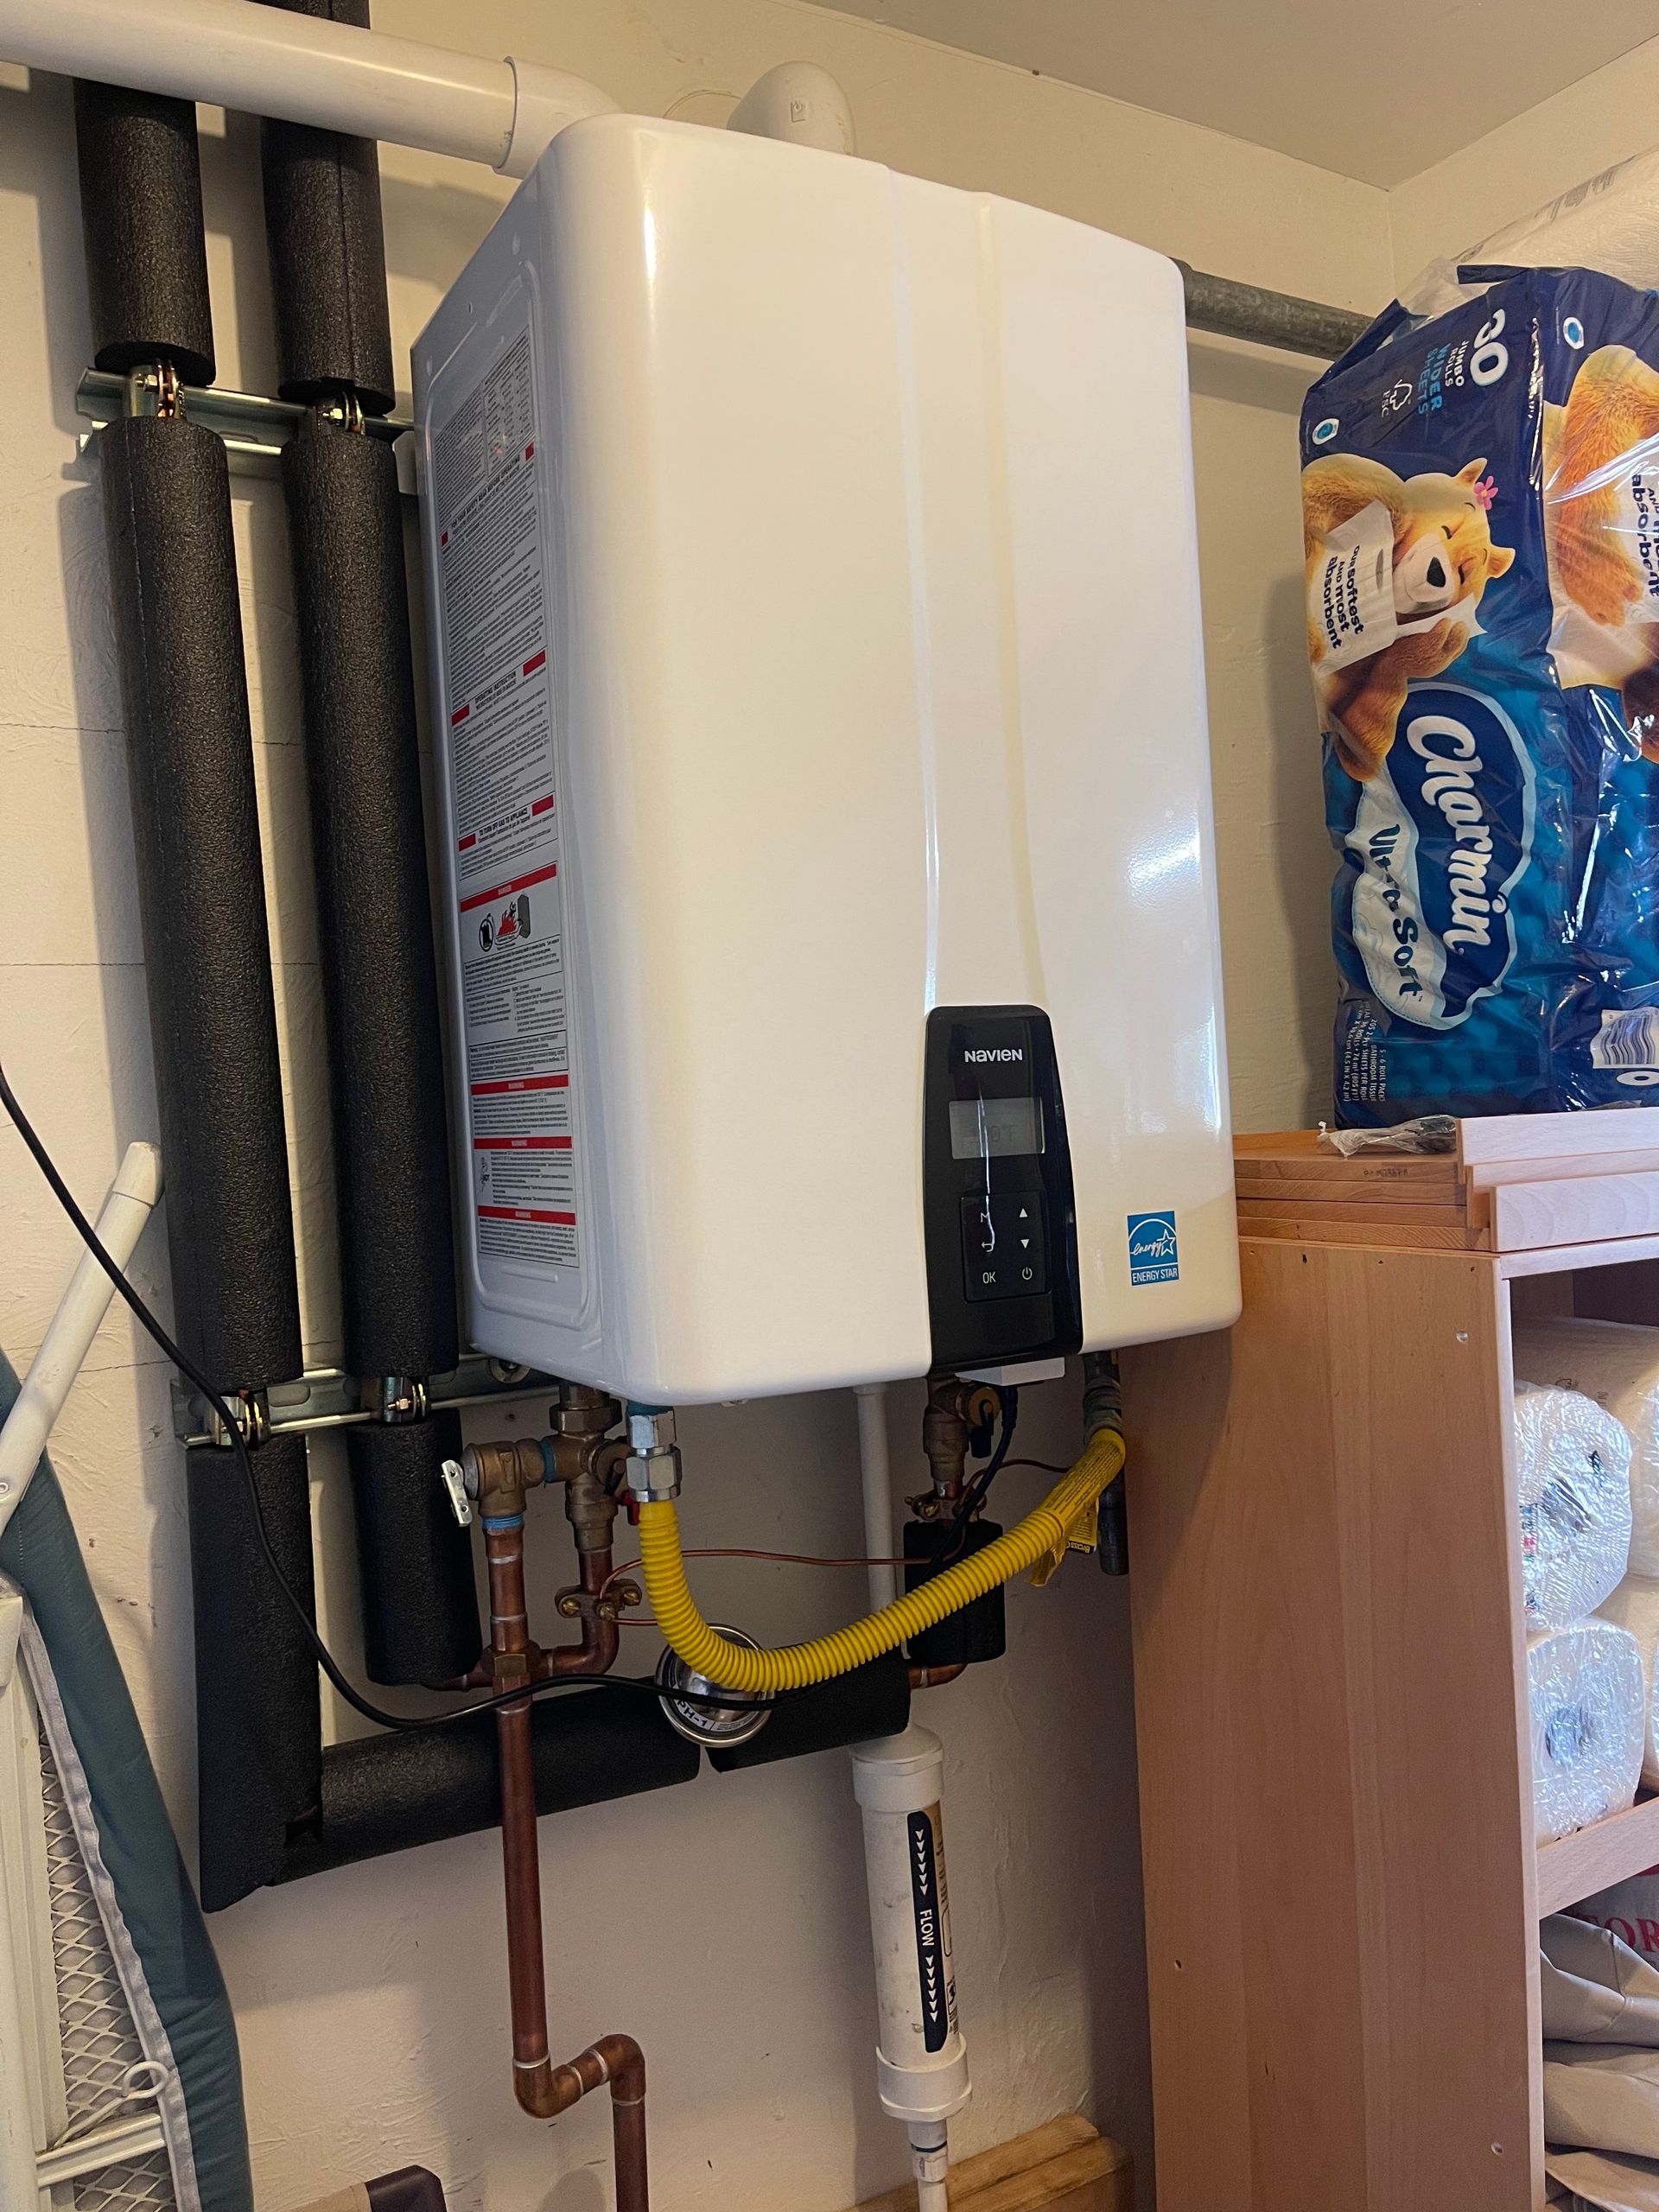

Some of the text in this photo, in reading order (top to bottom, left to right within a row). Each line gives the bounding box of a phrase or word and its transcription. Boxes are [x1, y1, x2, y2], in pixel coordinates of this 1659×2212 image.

[1418, 347, 1439, 414] SHEETS
[1429, 342, 1452, 411] WIDER
[1445, 347, 1459, 387] ROLLS
[1454, 340, 1469, 387] JUMBO
[1470, 308, 1509, 386] 30
[1631, 475, 1659, 597] absorbent
[1323, 556, 1342, 649] absorbent
[1335, 561, 1350, 632] AND most
[1346, 568, 1364, 635] softest
[1406, 715, 1509, 951] Charmin
[1369, 823, 1424, 997] Ultra Soft
[1353, 1028, 1364, 1047] ROLLS
[982, 1271, 996, 1284] OK
[1132, 1268, 1178, 1283] ENERGY STAR
[1133, 1242, 1163, 1258] energy
[919, 1909, 935, 1947] FLOW
